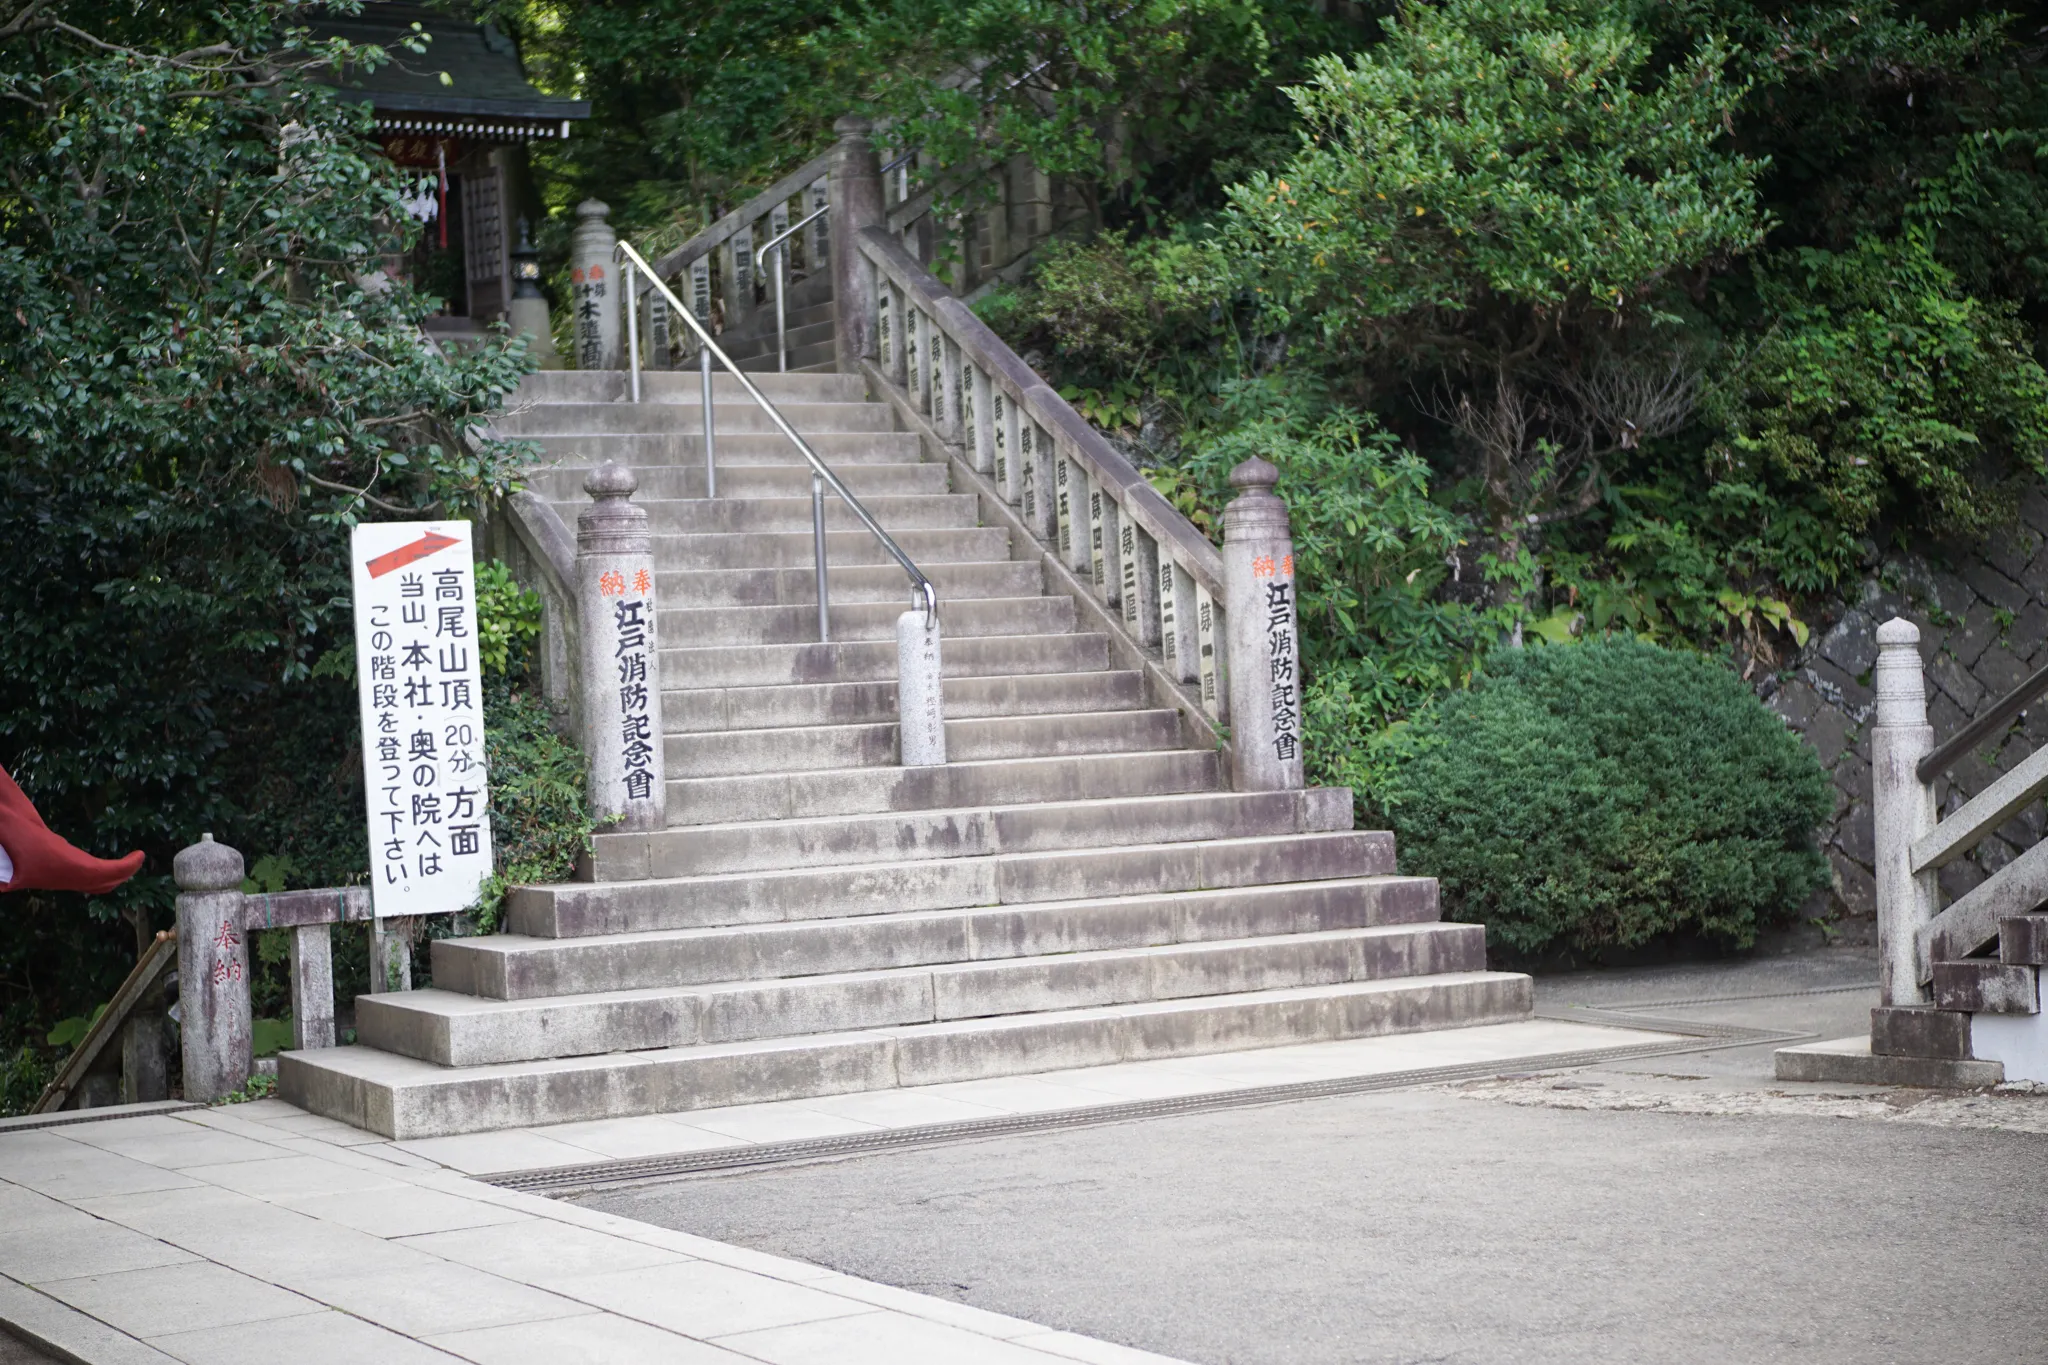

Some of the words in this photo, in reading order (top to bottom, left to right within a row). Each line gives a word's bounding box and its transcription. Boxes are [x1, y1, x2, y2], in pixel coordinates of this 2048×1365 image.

[369, 604, 411, 893] この階段を登って下さい。
[213, 919, 243, 985] 奉納
